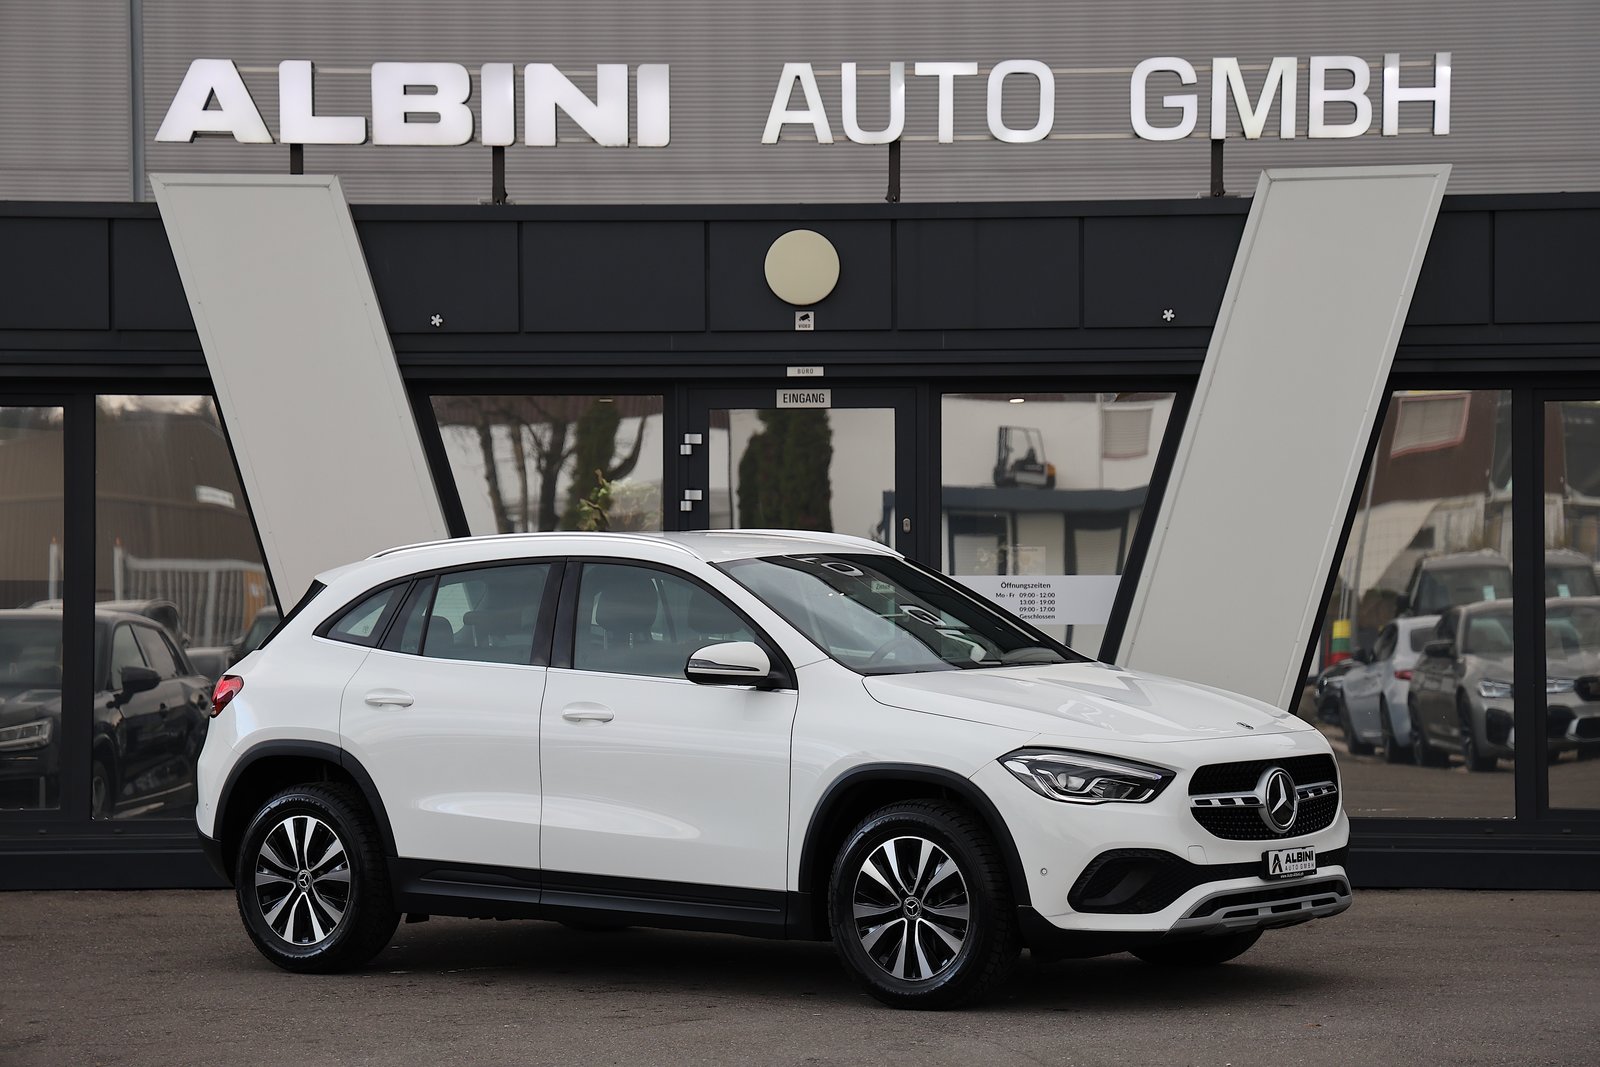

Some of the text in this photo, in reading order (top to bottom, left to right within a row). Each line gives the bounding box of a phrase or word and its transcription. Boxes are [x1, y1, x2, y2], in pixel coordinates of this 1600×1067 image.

[154, 52, 1452, 147] ALBINI AUTO GMBH
[797, 367, 814, 375] BÜRO
[783, 393, 825, 404] EINGANG
[1000, 581, 1051, 590] Öffnungszeiten
[1285, 850, 1314, 865] ALBINI
